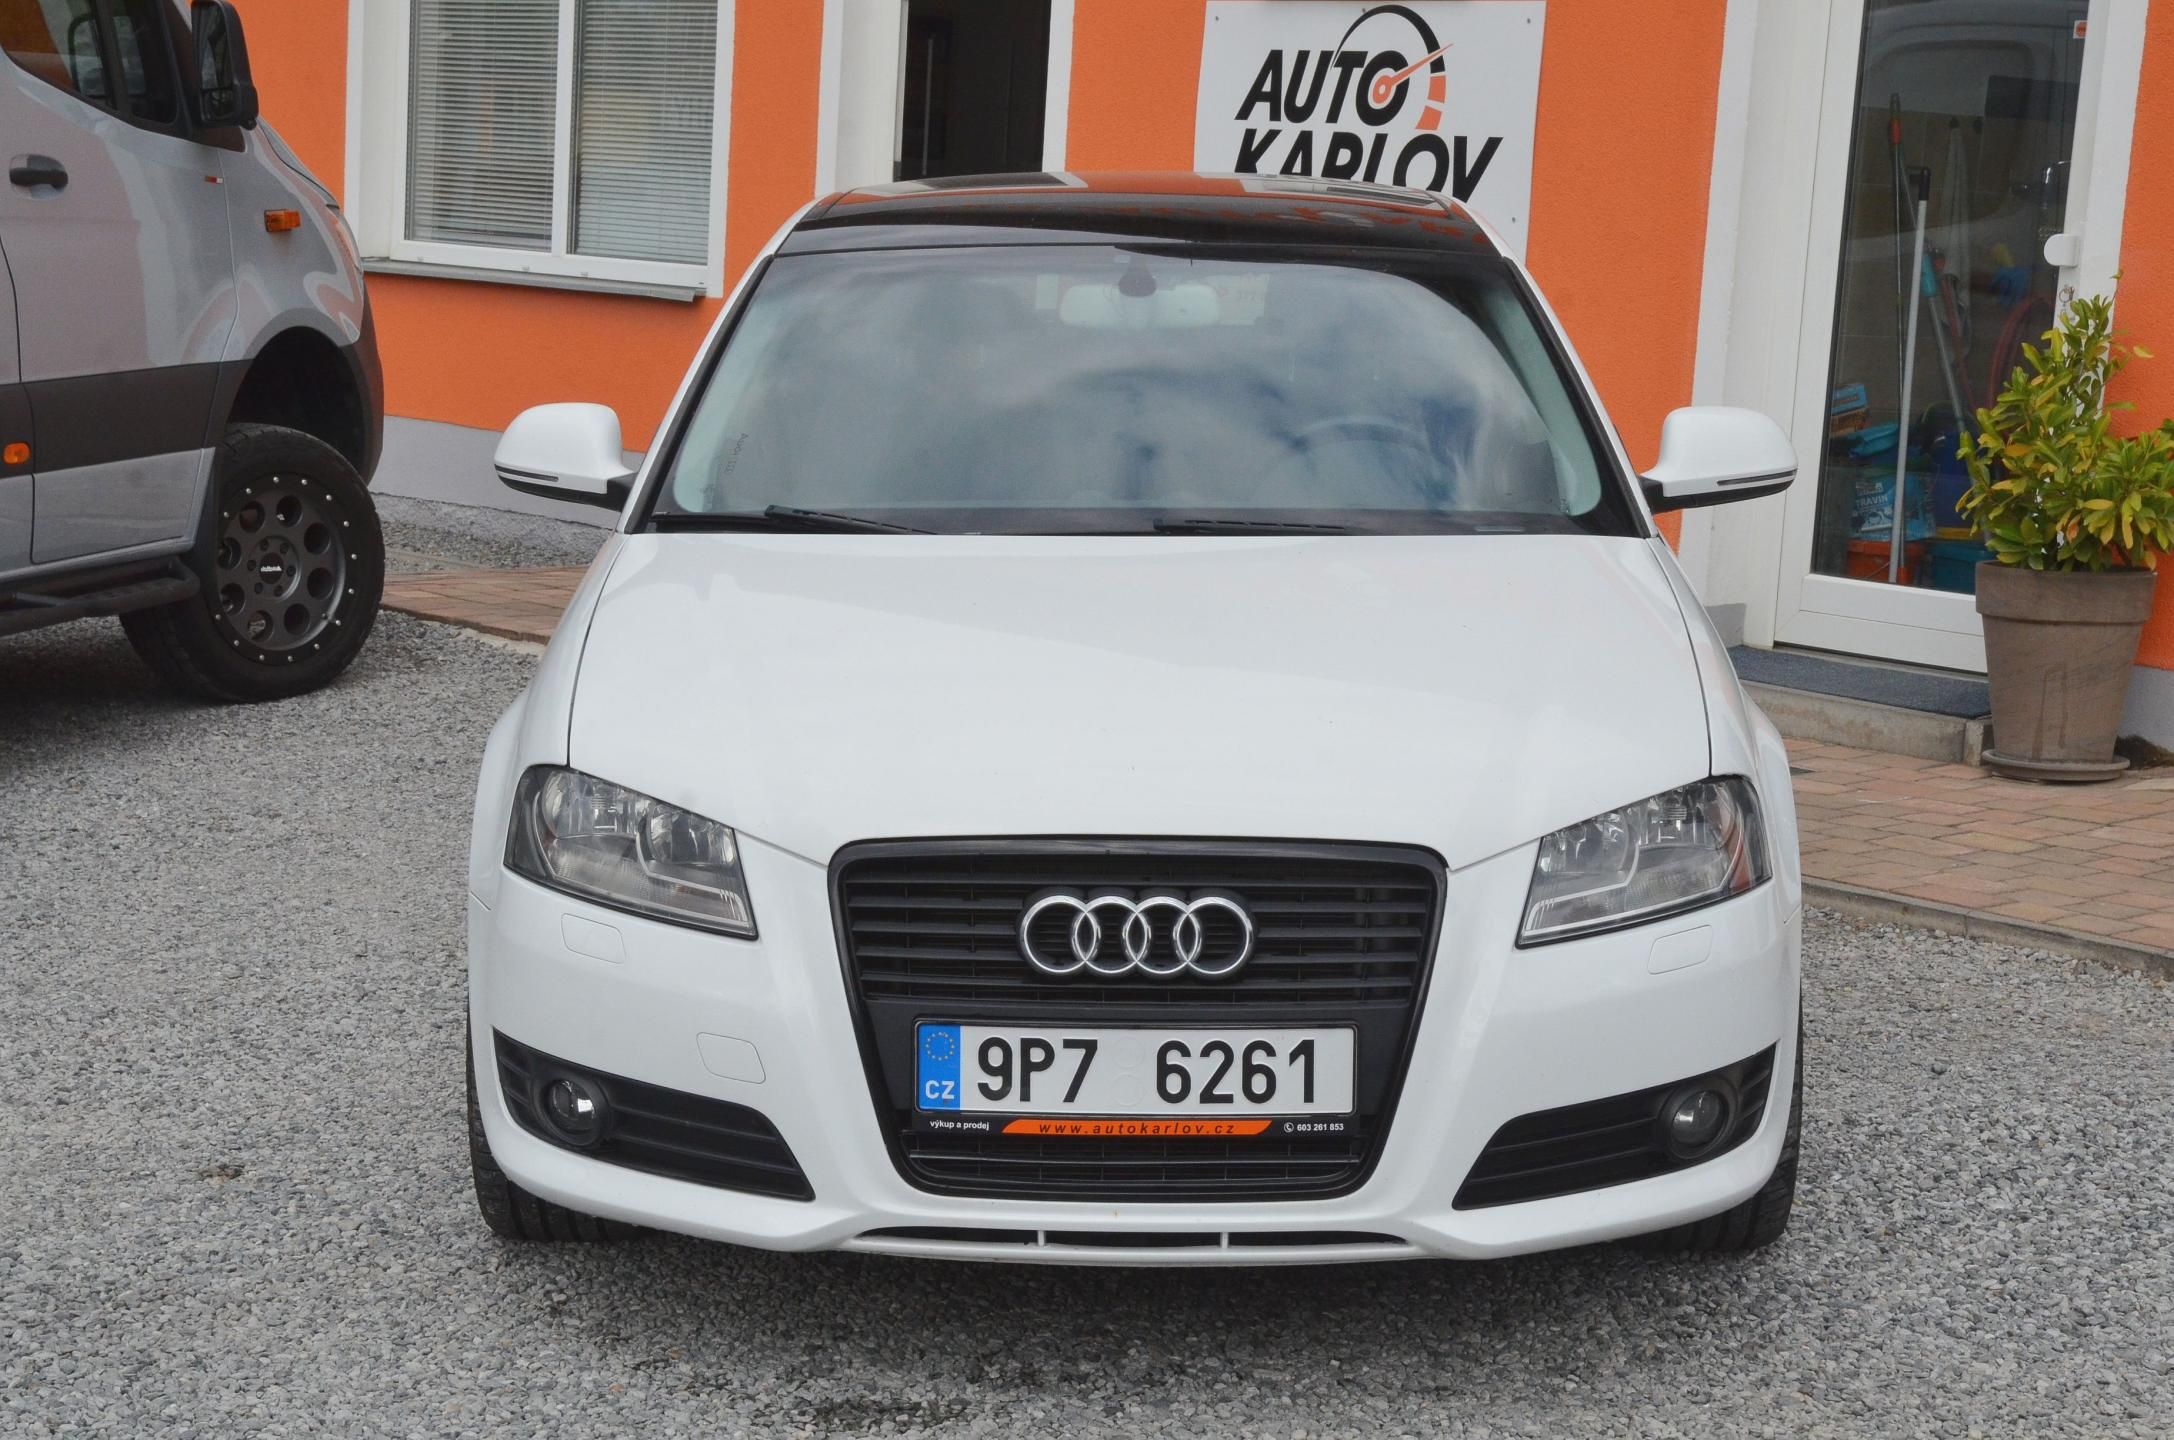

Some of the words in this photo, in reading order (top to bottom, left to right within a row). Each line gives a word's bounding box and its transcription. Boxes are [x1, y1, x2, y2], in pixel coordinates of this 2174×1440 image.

[1234, 49, 1410, 126] AUTO
[977, 1036, 1098, 1103] 9P7
[1156, 1039, 1315, 1104] 6261
[925, 1080, 955, 1100] CZ
[930, 1119, 954, 1130] výkup
[963, 1121, 990, 1131] prodej
[1039, 1122, 1235, 1134] www.autokarlov.cz
[1297, 1123, 1312, 1131] 603
[1313, 1123, 1328, 1131] 261
[1329, 1123, 1344, 1131] 853
